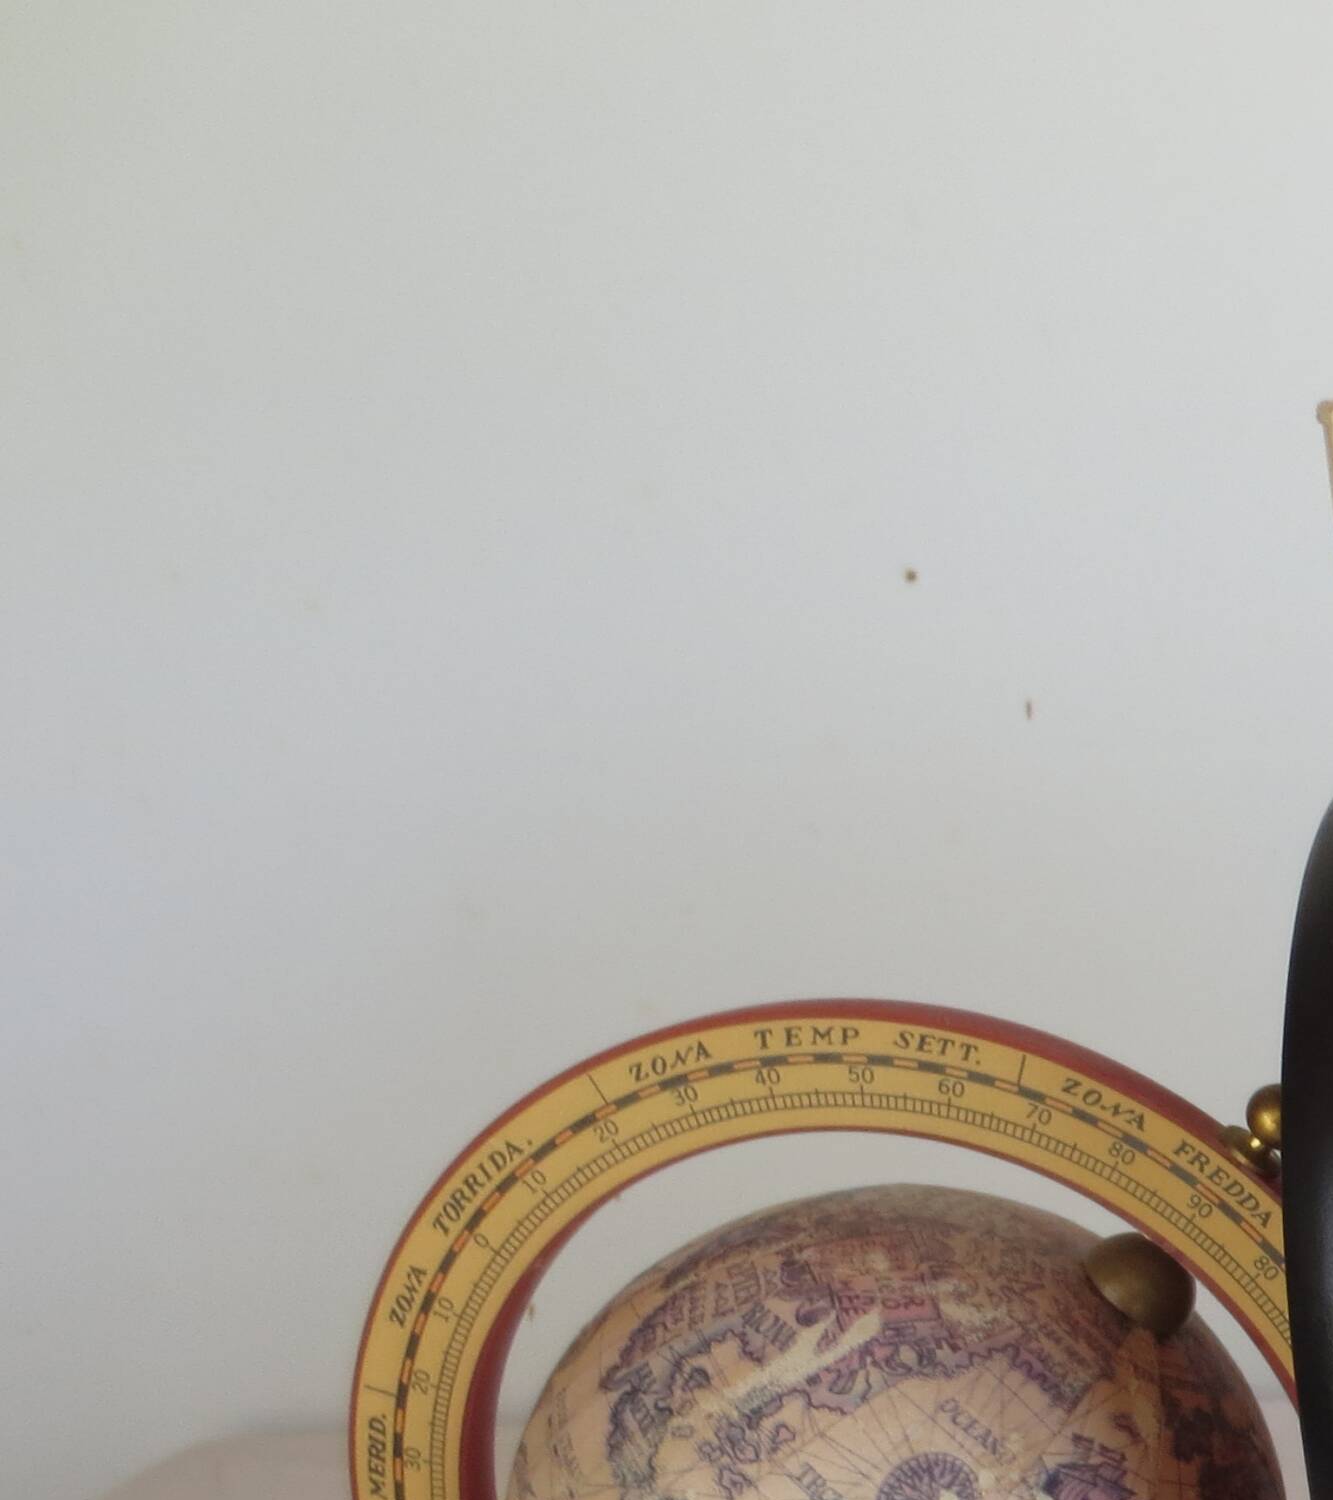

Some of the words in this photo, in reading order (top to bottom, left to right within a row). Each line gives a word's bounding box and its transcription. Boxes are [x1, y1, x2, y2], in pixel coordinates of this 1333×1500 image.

[629, 1041, 712, 1083] ZONA
[753, 1025, 860, 1050] TEMP
[893, 1030, 981, 1065] SETT.
[755, 1068, 781, 1086] 40
[848, 1068, 875, 1085] 50
[938, 1078, 965, 1098] 60
[675, 1085, 698, 1106] 30
[1026, 1102, 1053, 1125] 70
[593, 1119, 619, 1143] 20
[1062, 1078, 1146, 1132] ZONA
[1174, 1139, 1276, 1229] FREDDA
[1108, 1140, 1135, 1166] 80
[522, 1169, 547, 1195] 10
[1187, 1193, 1214, 1219] 90
[473, 1233, 489, 1249] 0
[1254, 1255, 1280, 1281] 80
[389, 1265, 428, 1328] ZONA
[433, 1296, 454, 1324] 10
[412, 1368, 432, 1396] 20
[404, 1446, 421, 1473] 30
